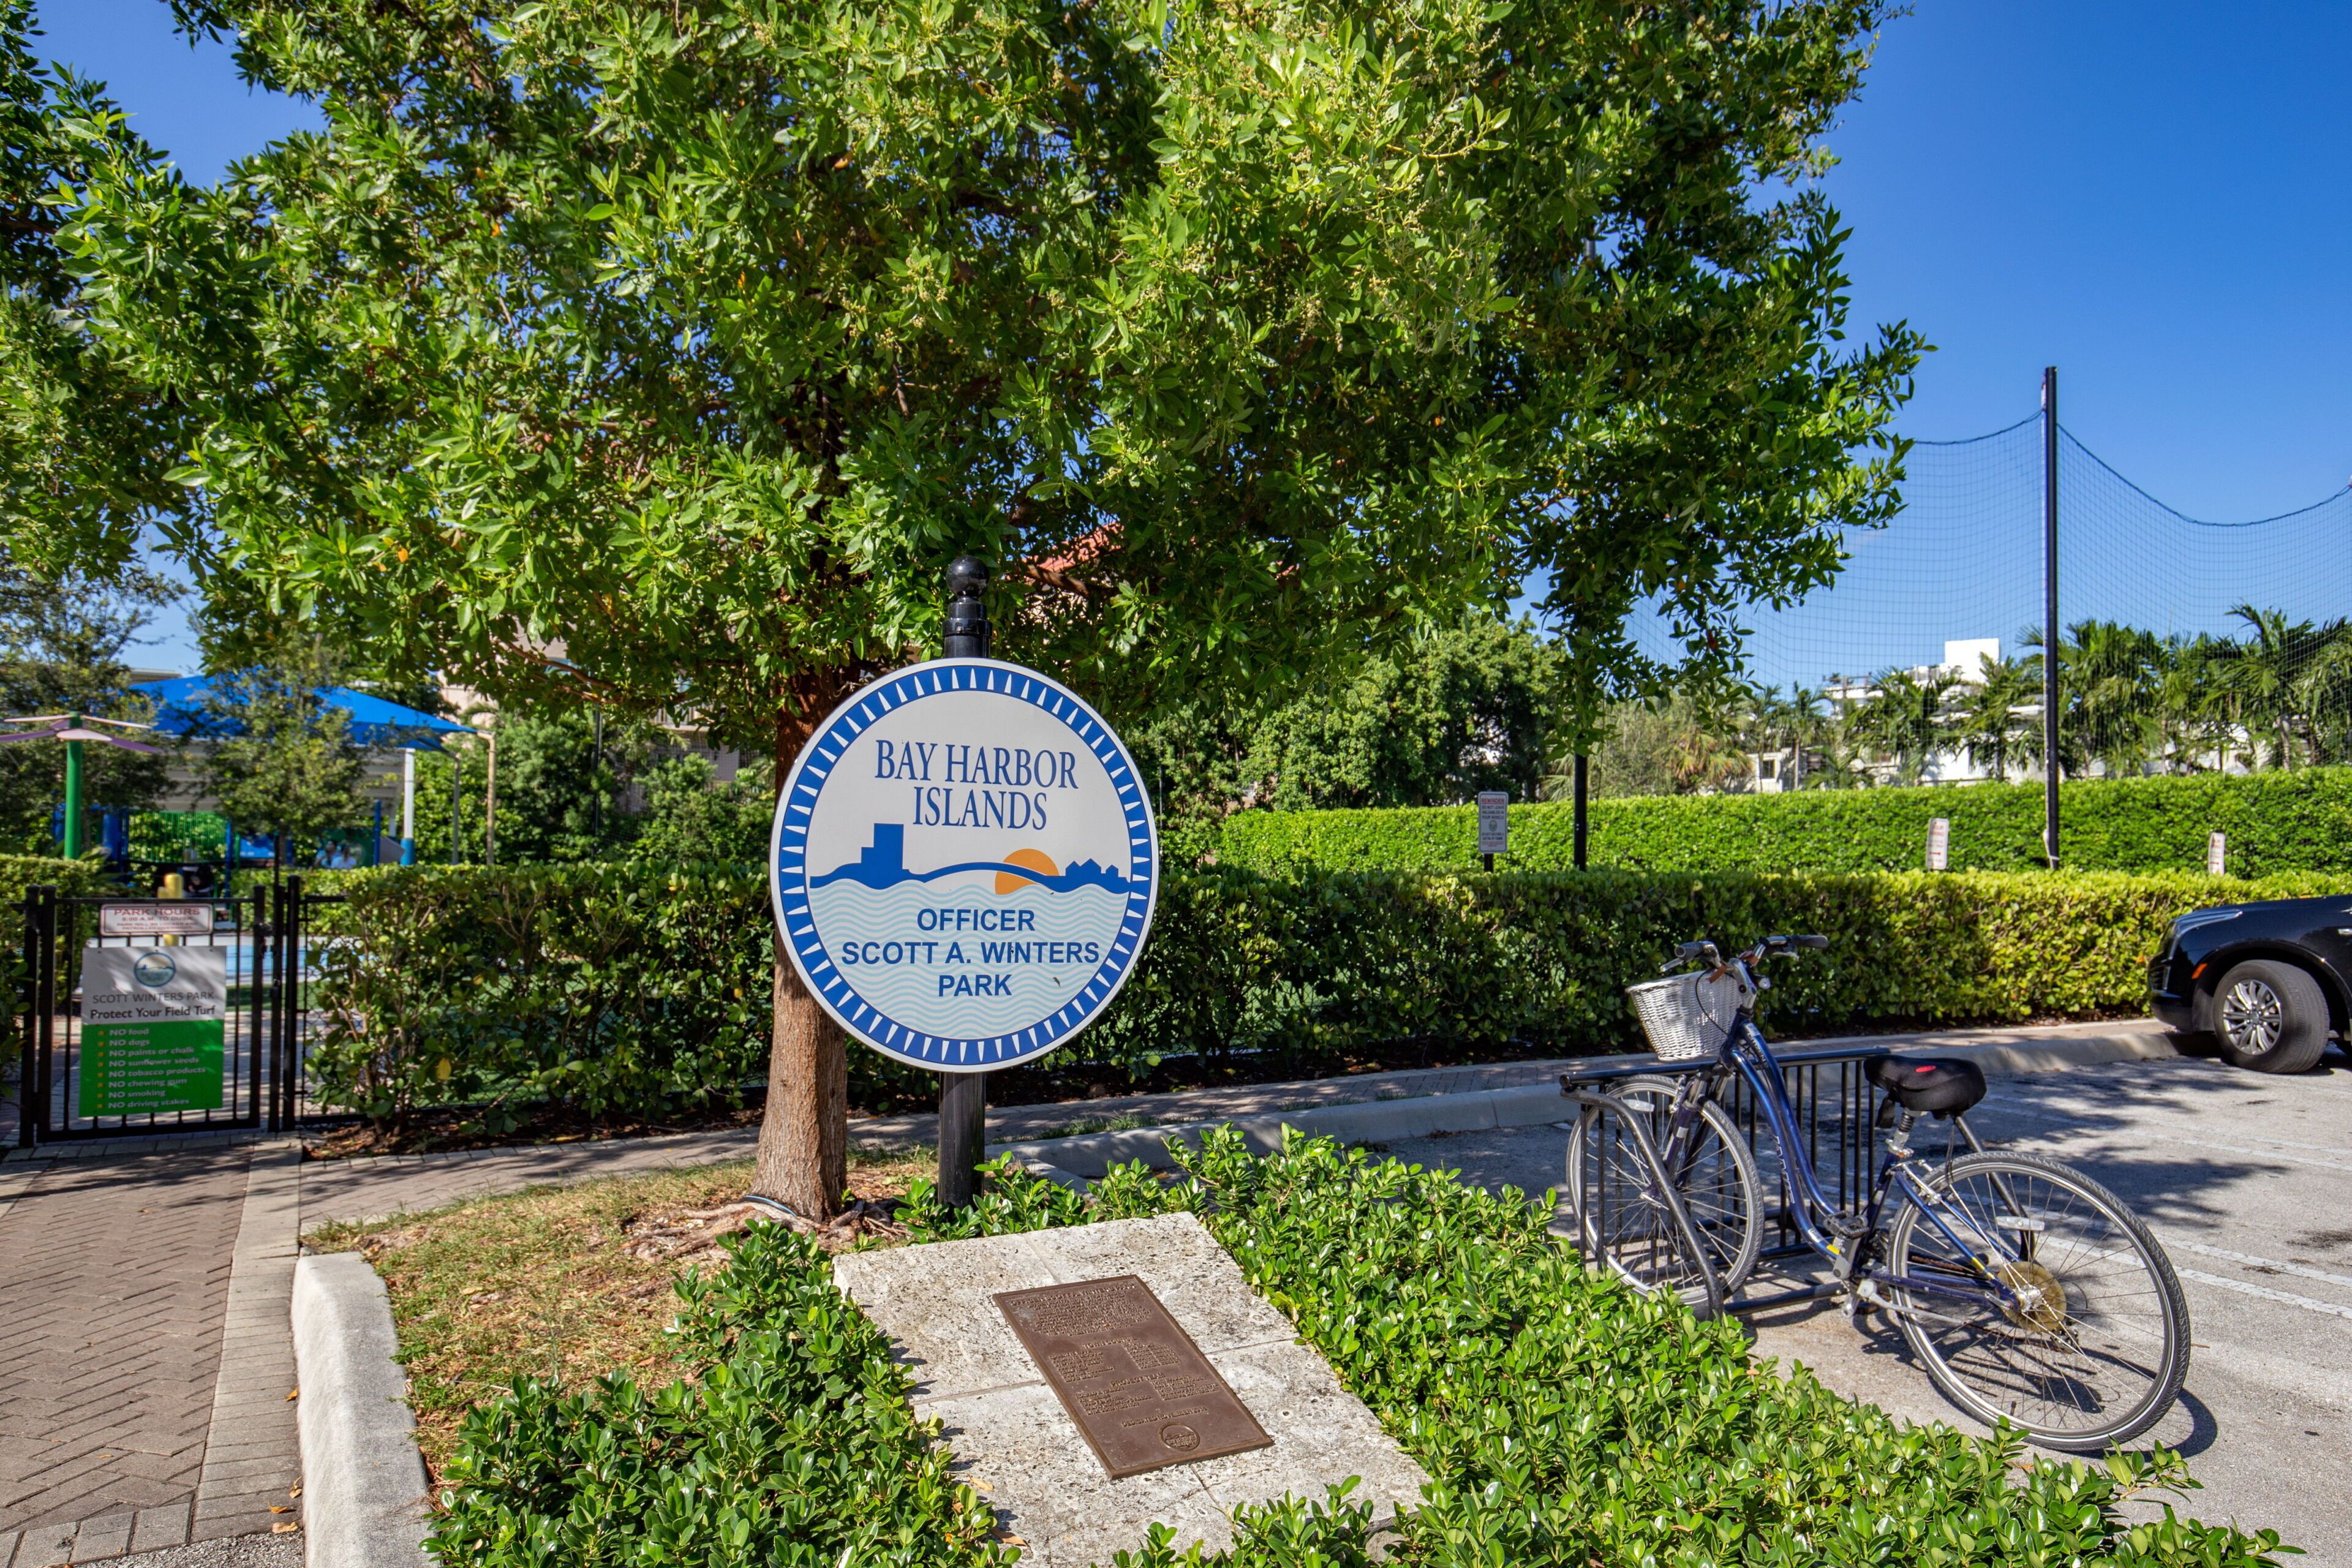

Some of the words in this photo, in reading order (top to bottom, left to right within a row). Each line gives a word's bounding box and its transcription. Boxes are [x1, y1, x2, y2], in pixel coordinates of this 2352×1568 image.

[875, 739, 938, 781] BAY
[944, 744, 1079, 789] HARBOR
[913, 786, 1047, 830] ISLANDS
[917, 908, 1035, 931] OFFICER
[842, 941, 938, 964] SCOTT
[945, 942, 971, 963] A.
[981, 941, 1099, 963] WINTERS
[938, 974, 1012, 997] PARK
[92, 993, 129, 1003] SCOTT
[133, 992, 184, 1002] WINTERS
[187, 991, 214, 1000] PARK
[91, 1009, 132, 1019] Protect
[137, 1008, 163, 1017] Your
[165, 1006, 190, 1016] Field
[195, 1005, 216, 1015] Turf
[128, 1049, 156, 1058] paints
[128, 1079, 165, 1088] chewing
[1110, 1377, 1144, 1387] PROJECT
